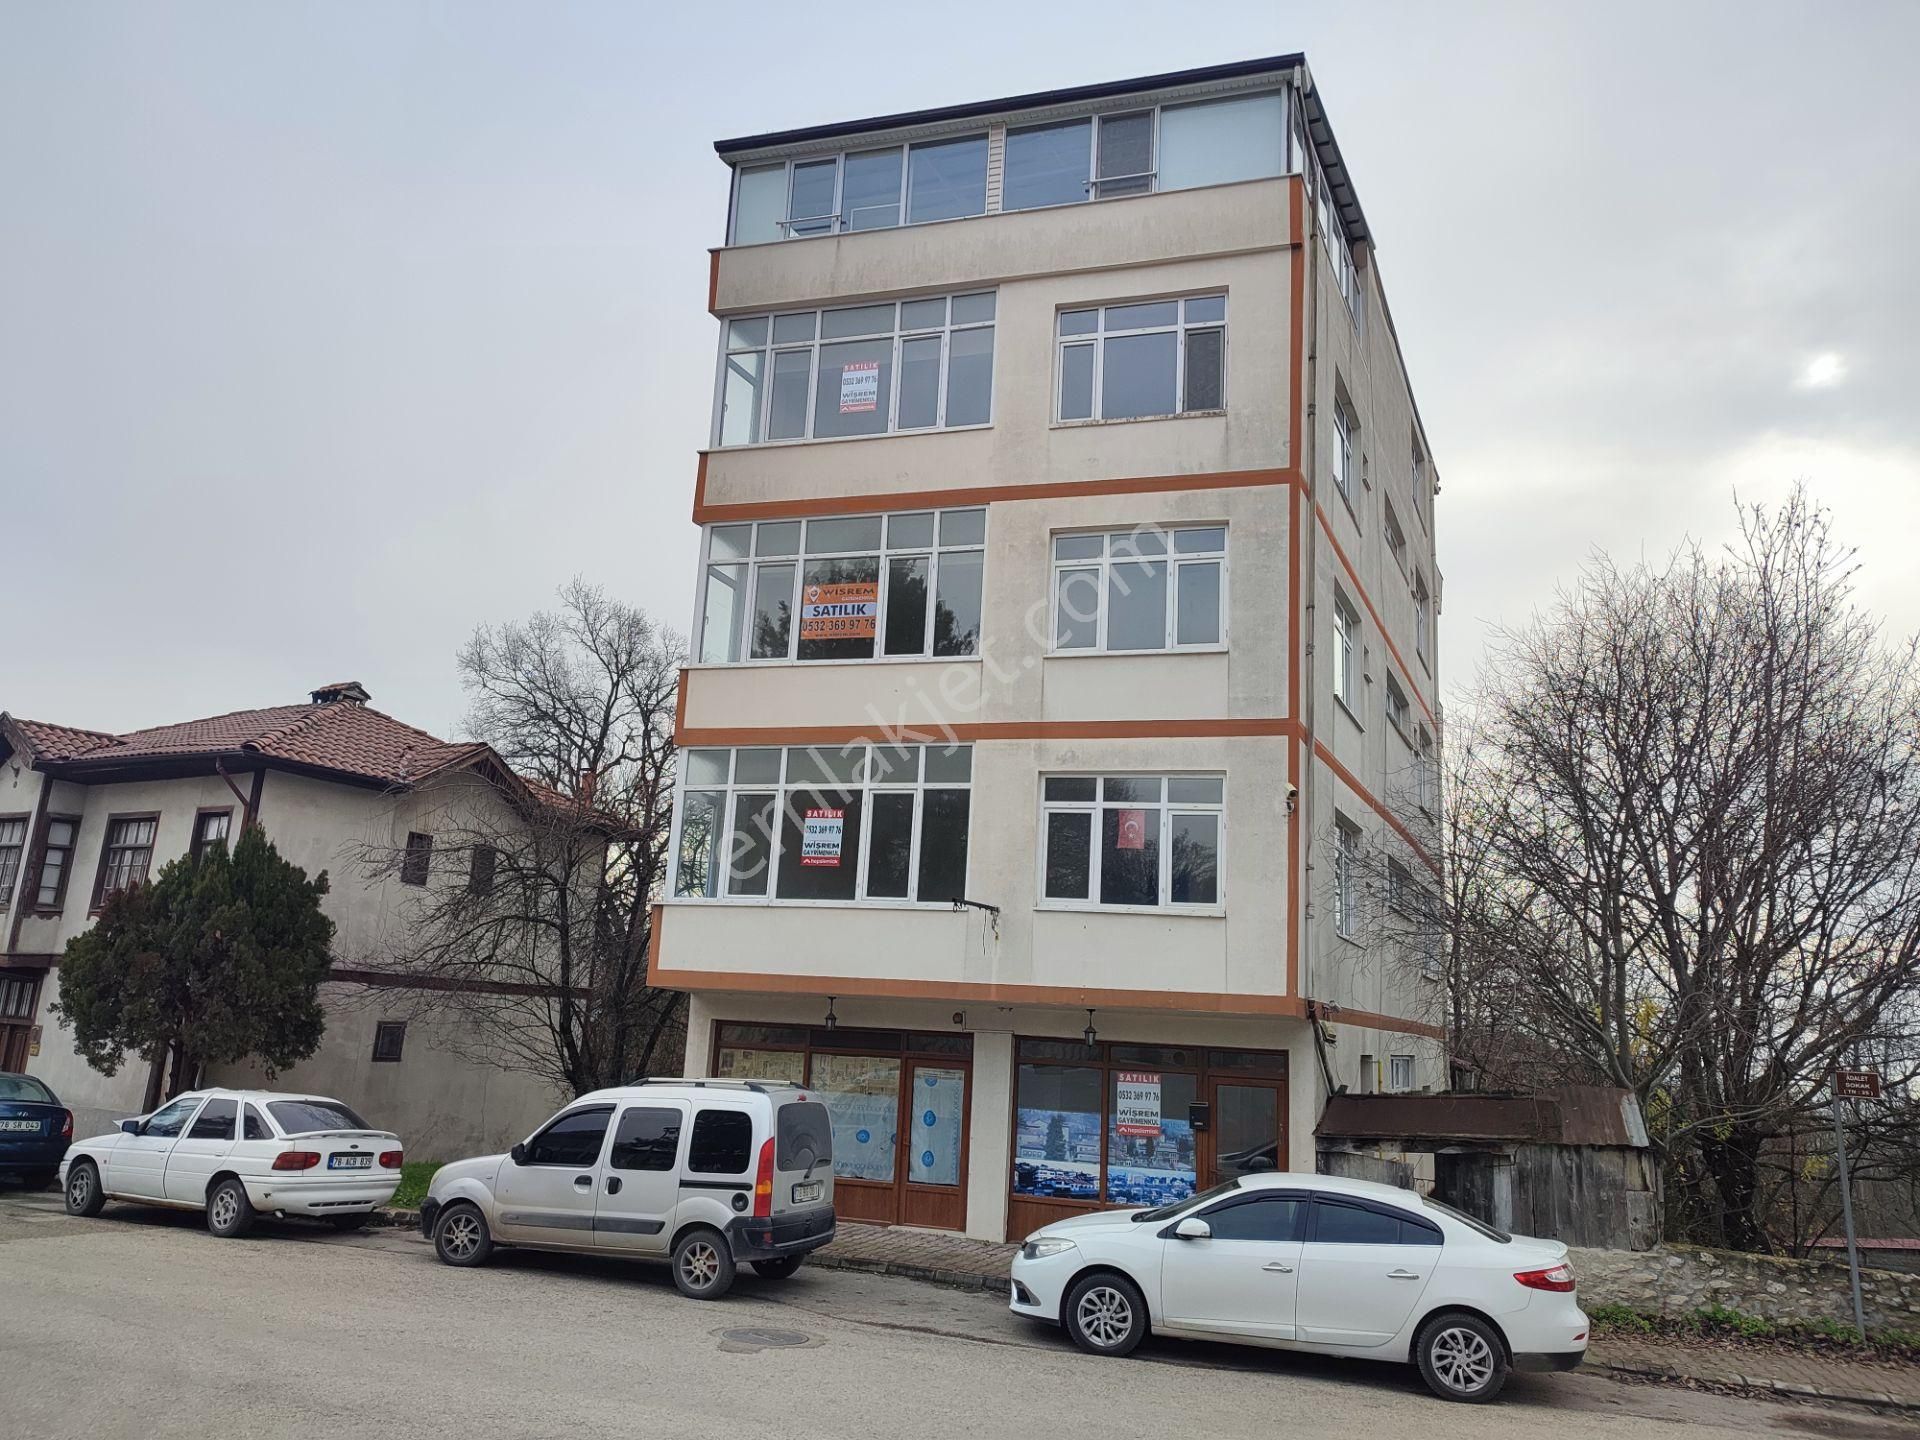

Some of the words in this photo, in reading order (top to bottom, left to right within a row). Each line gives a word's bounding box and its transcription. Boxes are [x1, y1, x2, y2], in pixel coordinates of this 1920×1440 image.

[844, 362, 878, 371] SATILIK
[812, 603, 867, 617] SATILIK
[802, 620, 825, 632] 0532
[828, 620, 846, 631] 369
[849, 619, 860, 630] 97
[864, 618, 876, 630] 76
[806, 809, 842, 818] SATILIK
[835, 825, 841, 835] 76
[1119, 1073, 1159, 1083] SATILIK
[1119, 1090, 1132, 1100] 0532
[1133, 1091, 1143, 1101] 369
[1145, 1091, 1151, 1101] 97
[1153, 1092, 1159, 1101] 76
[1119, 1108, 1159, 1117] WİŞREM
